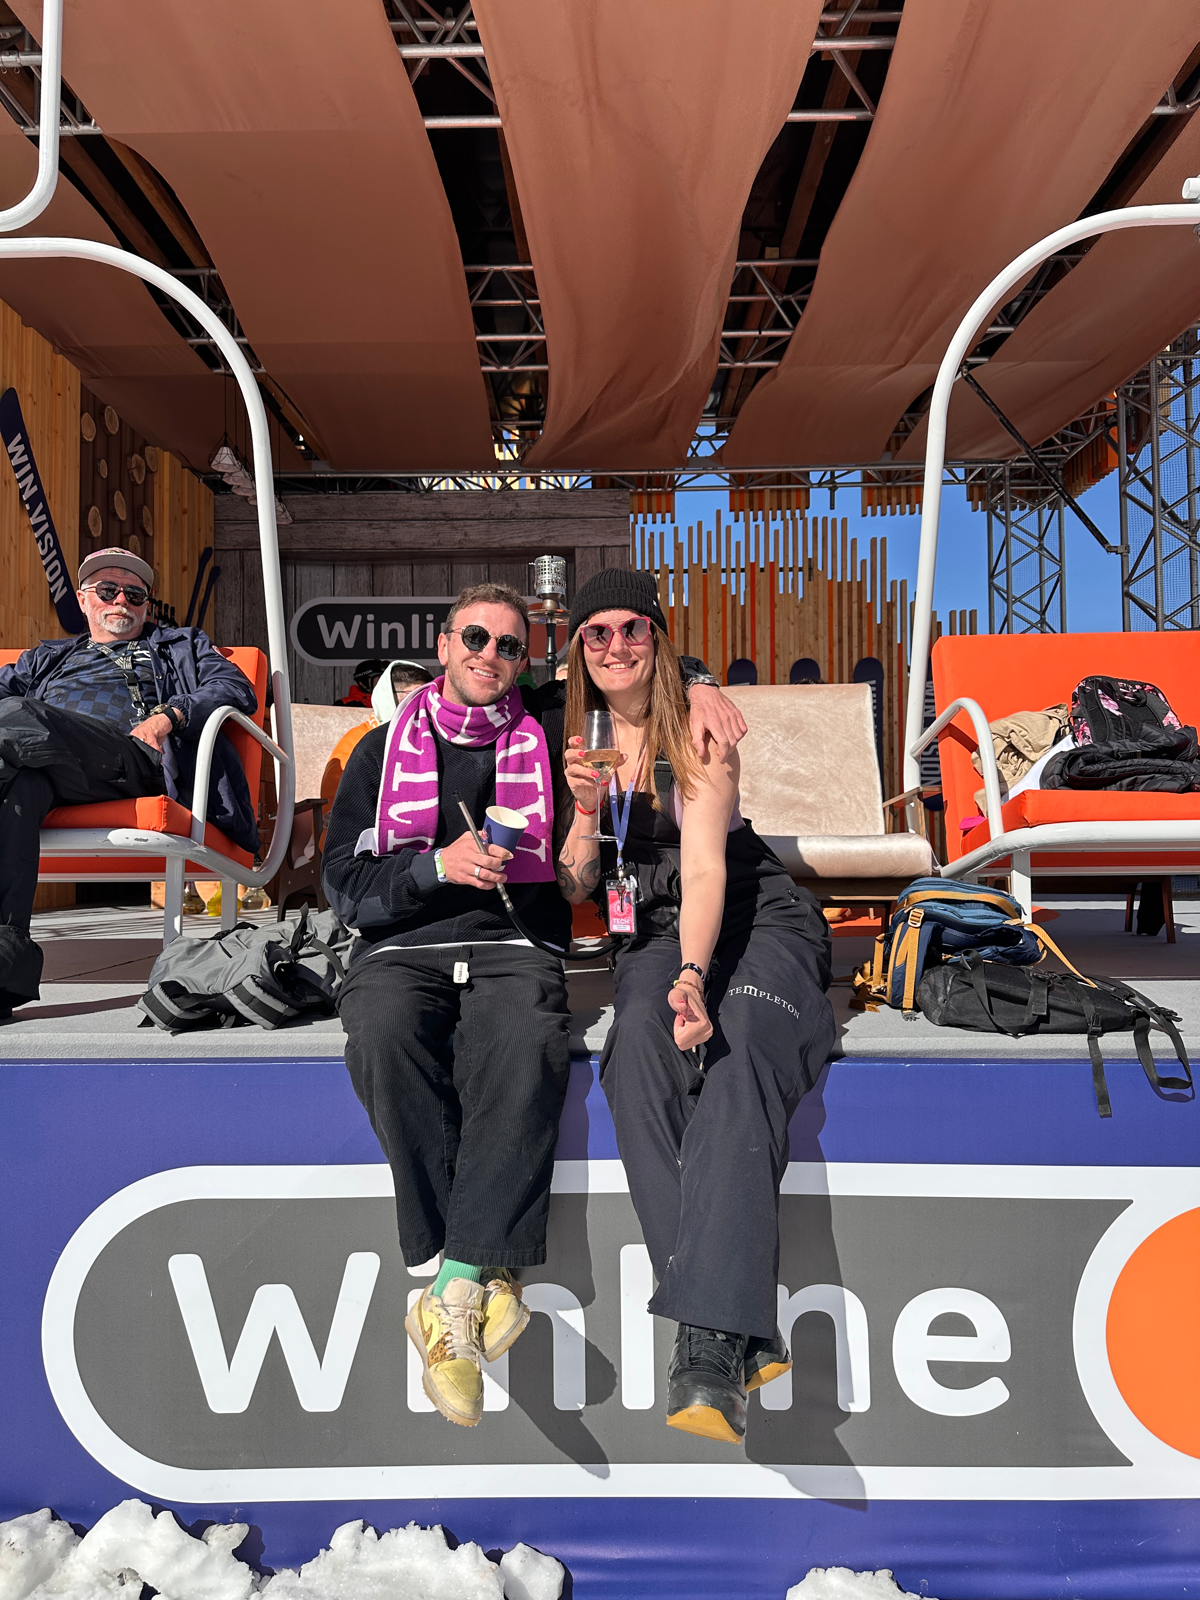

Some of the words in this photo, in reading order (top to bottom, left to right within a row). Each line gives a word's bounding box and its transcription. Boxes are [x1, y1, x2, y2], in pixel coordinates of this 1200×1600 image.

[7, 432, 68, 604] WIN.VISION
[316, 613, 447, 649] Winli
[728, 985, 801, 1020] TEMPLETON
[168, 1244, 1012, 1417] Wnlne
